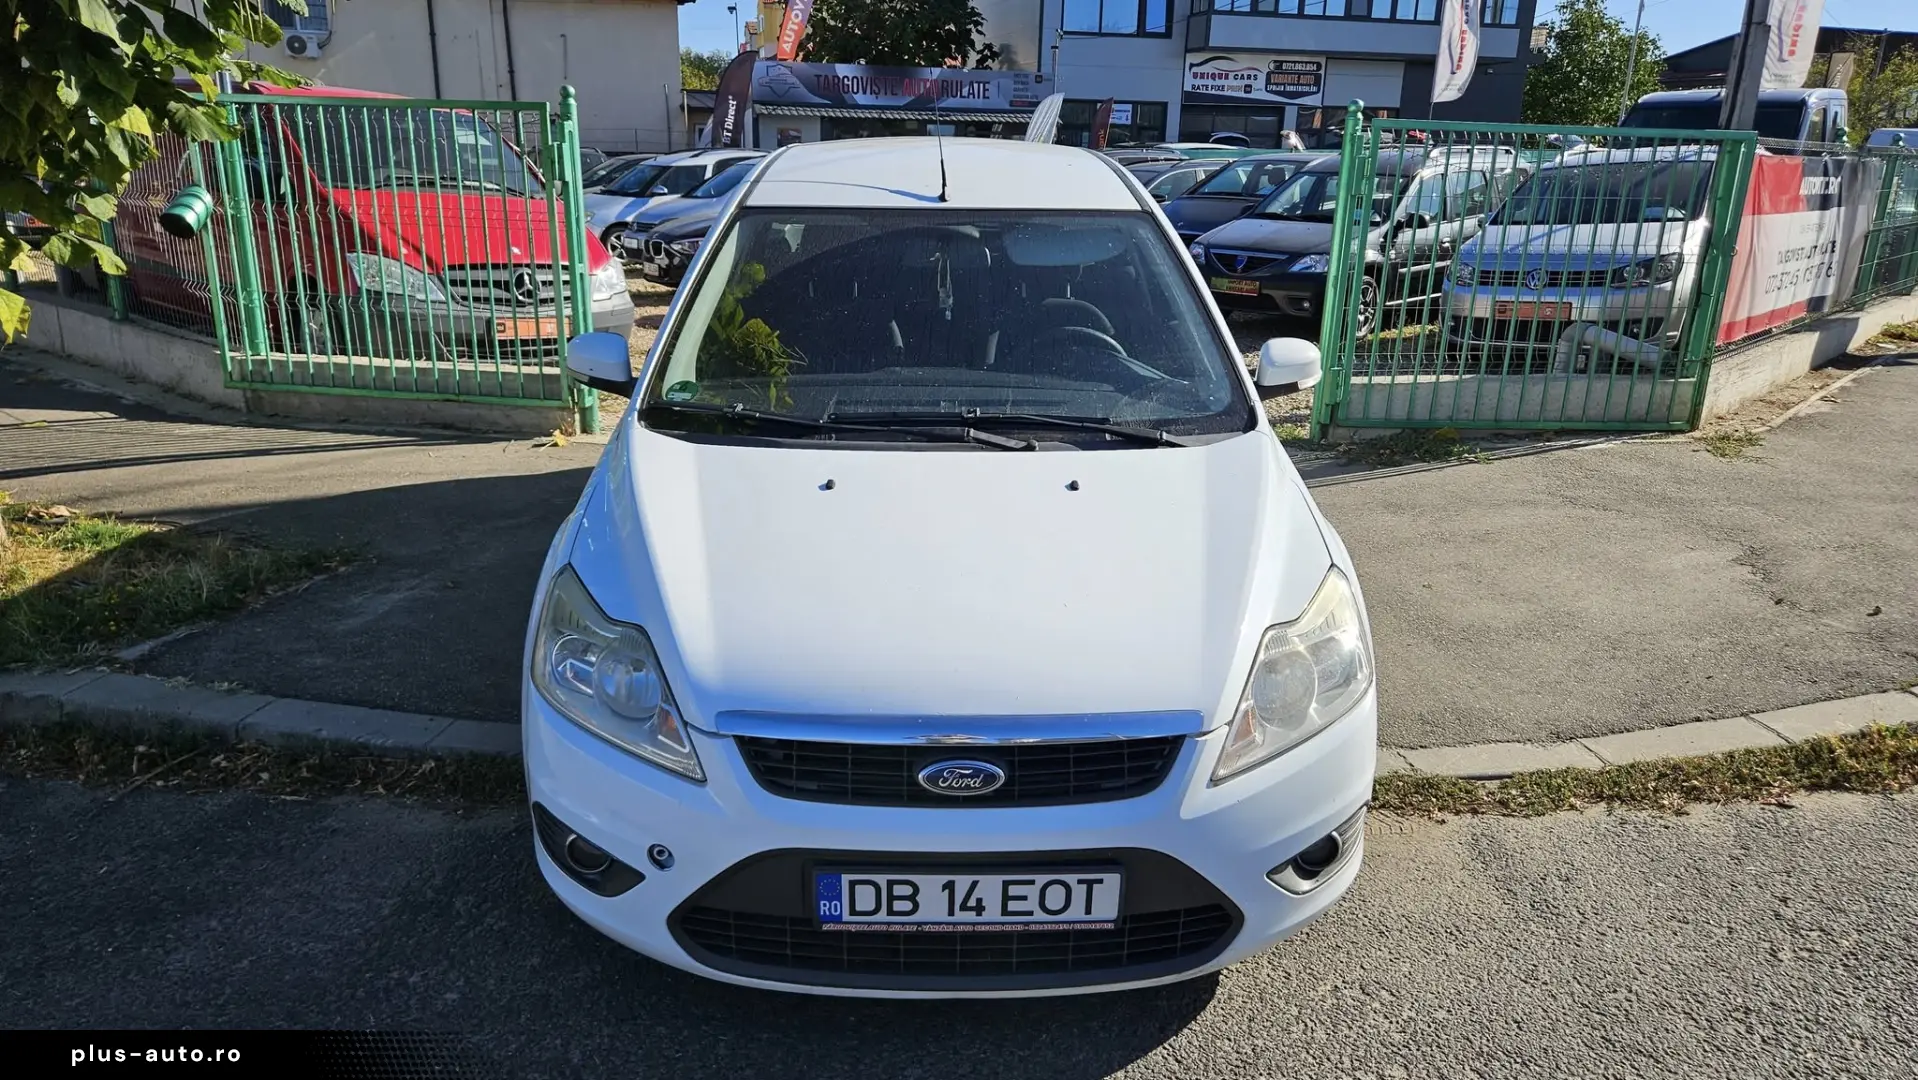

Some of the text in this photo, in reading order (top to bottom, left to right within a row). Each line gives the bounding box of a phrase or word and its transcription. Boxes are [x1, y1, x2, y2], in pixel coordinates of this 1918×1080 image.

[1192, 71, 1259, 81] UNIQUE CARS
[1270, 74, 1315, 84] VARIANTE AUTO
[940, 78, 990, 99] RULATE
[1191, 83, 1210, 91] RATE
[1211, 83, 1226, 92] FIXE
[939, 768, 984, 788] Ford
[847, 878, 1104, 917] DB 14 EOT
[819, 901, 841, 916] RO
